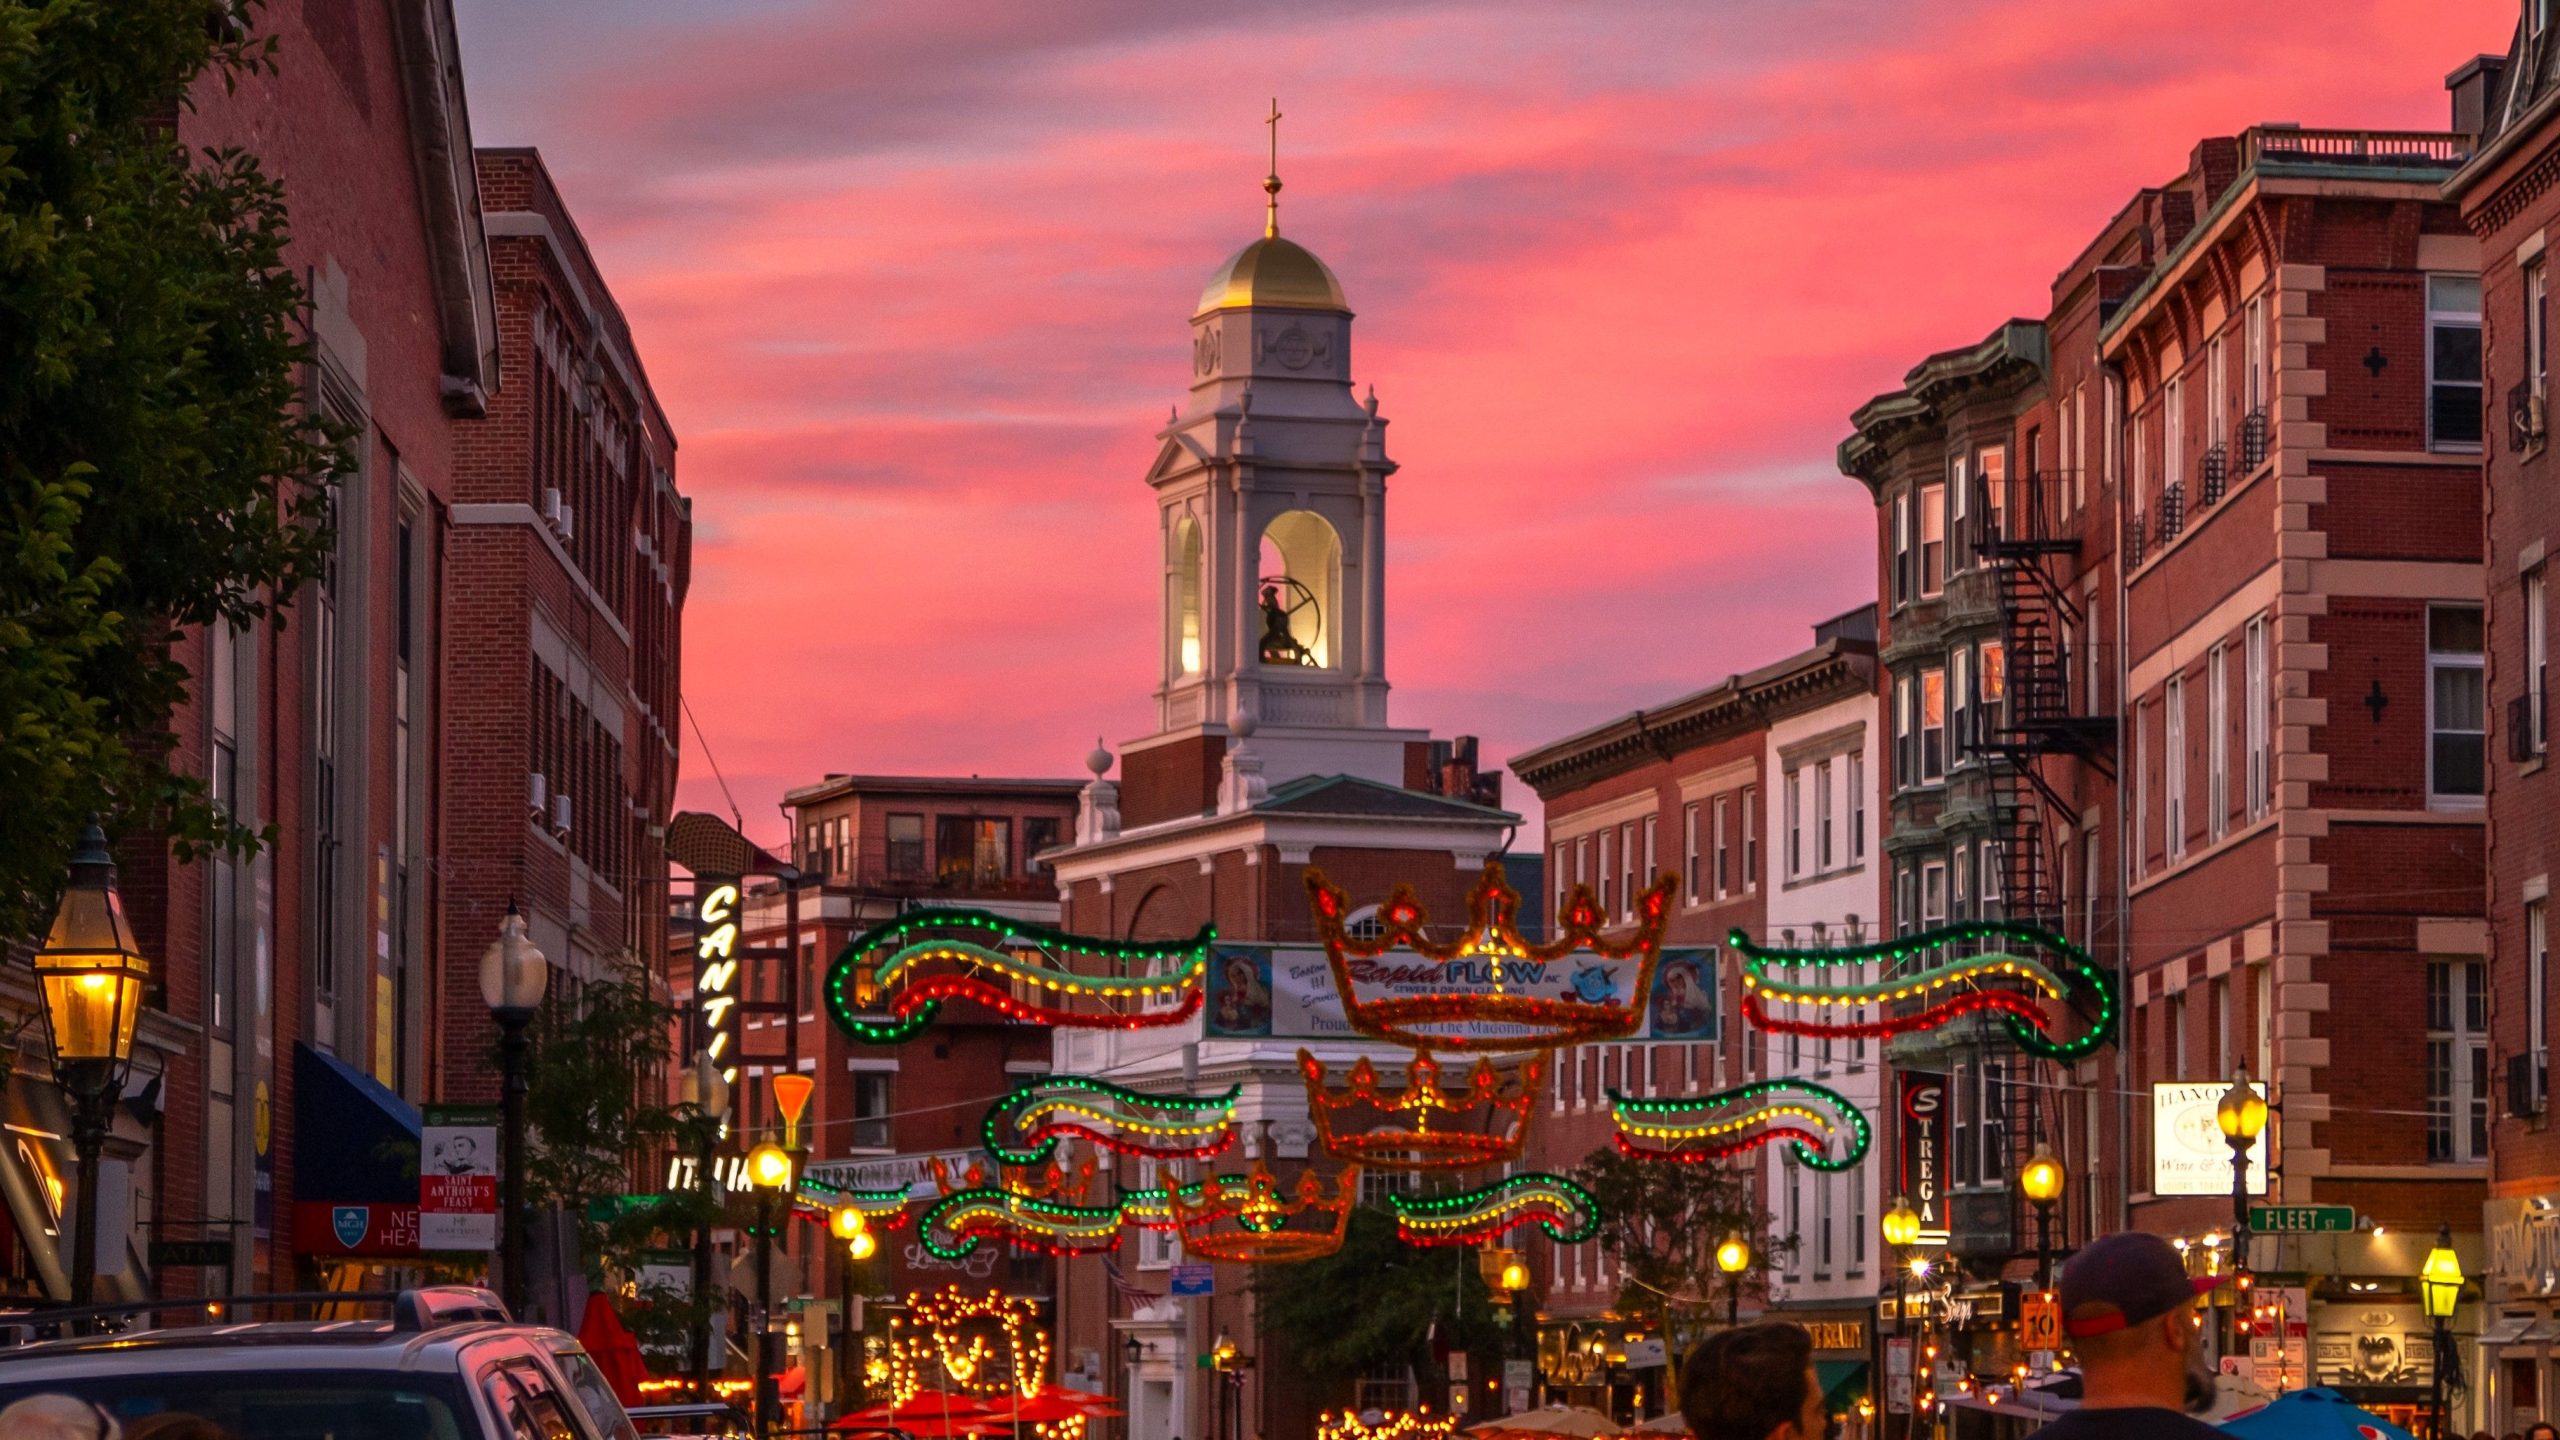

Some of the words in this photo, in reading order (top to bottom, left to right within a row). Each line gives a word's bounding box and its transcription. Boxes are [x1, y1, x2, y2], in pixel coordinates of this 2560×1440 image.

[1349, 959, 1447, 988] Rapid
[1446, 961, 1547, 984] FLOW
[1393, 985, 1427, 994] SEWER
[1440, 985, 1472, 995] DRAIN
[1474, 985, 1526, 995] CLEING
[700, 885, 738, 1141] CANTI
[1913, 1086, 1942, 1222] STREGA
[2160, 1159, 2194, 1171] Wine
[444, 1175, 473, 1186] SAINT
[430, 1185, 490, 1197] ANTHONY'S
[443, 1196, 473, 1208] FEAST
[338, 1221, 364, 1229] MGH
[391, 1210, 419, 1229] NE
[2265, 1210, 2318, 1230] FLEET
[2324, 1219, 2335, 1230] ST
[2028, 1315, 2055, 1343] 10
